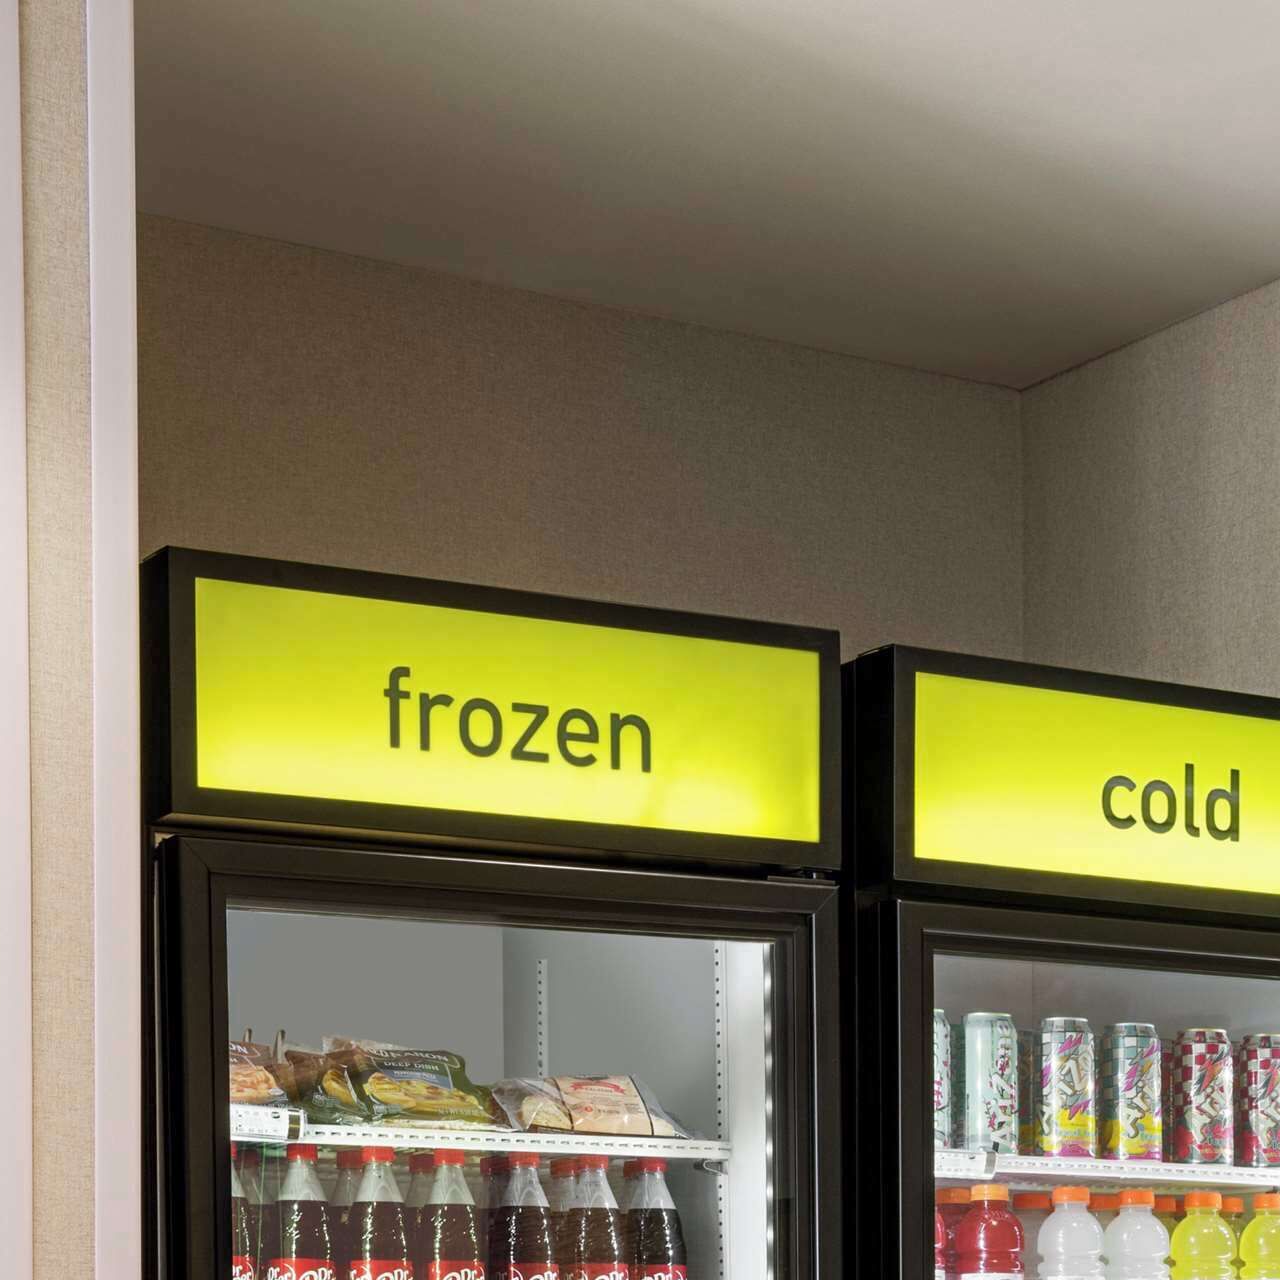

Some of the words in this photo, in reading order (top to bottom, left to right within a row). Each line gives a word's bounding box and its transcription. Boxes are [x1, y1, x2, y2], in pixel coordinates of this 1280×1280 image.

[384, 666, 653, 774] frozen
[1102, 762, 1242, 843] cold
[319, 1267, 332, 1280] Dr
